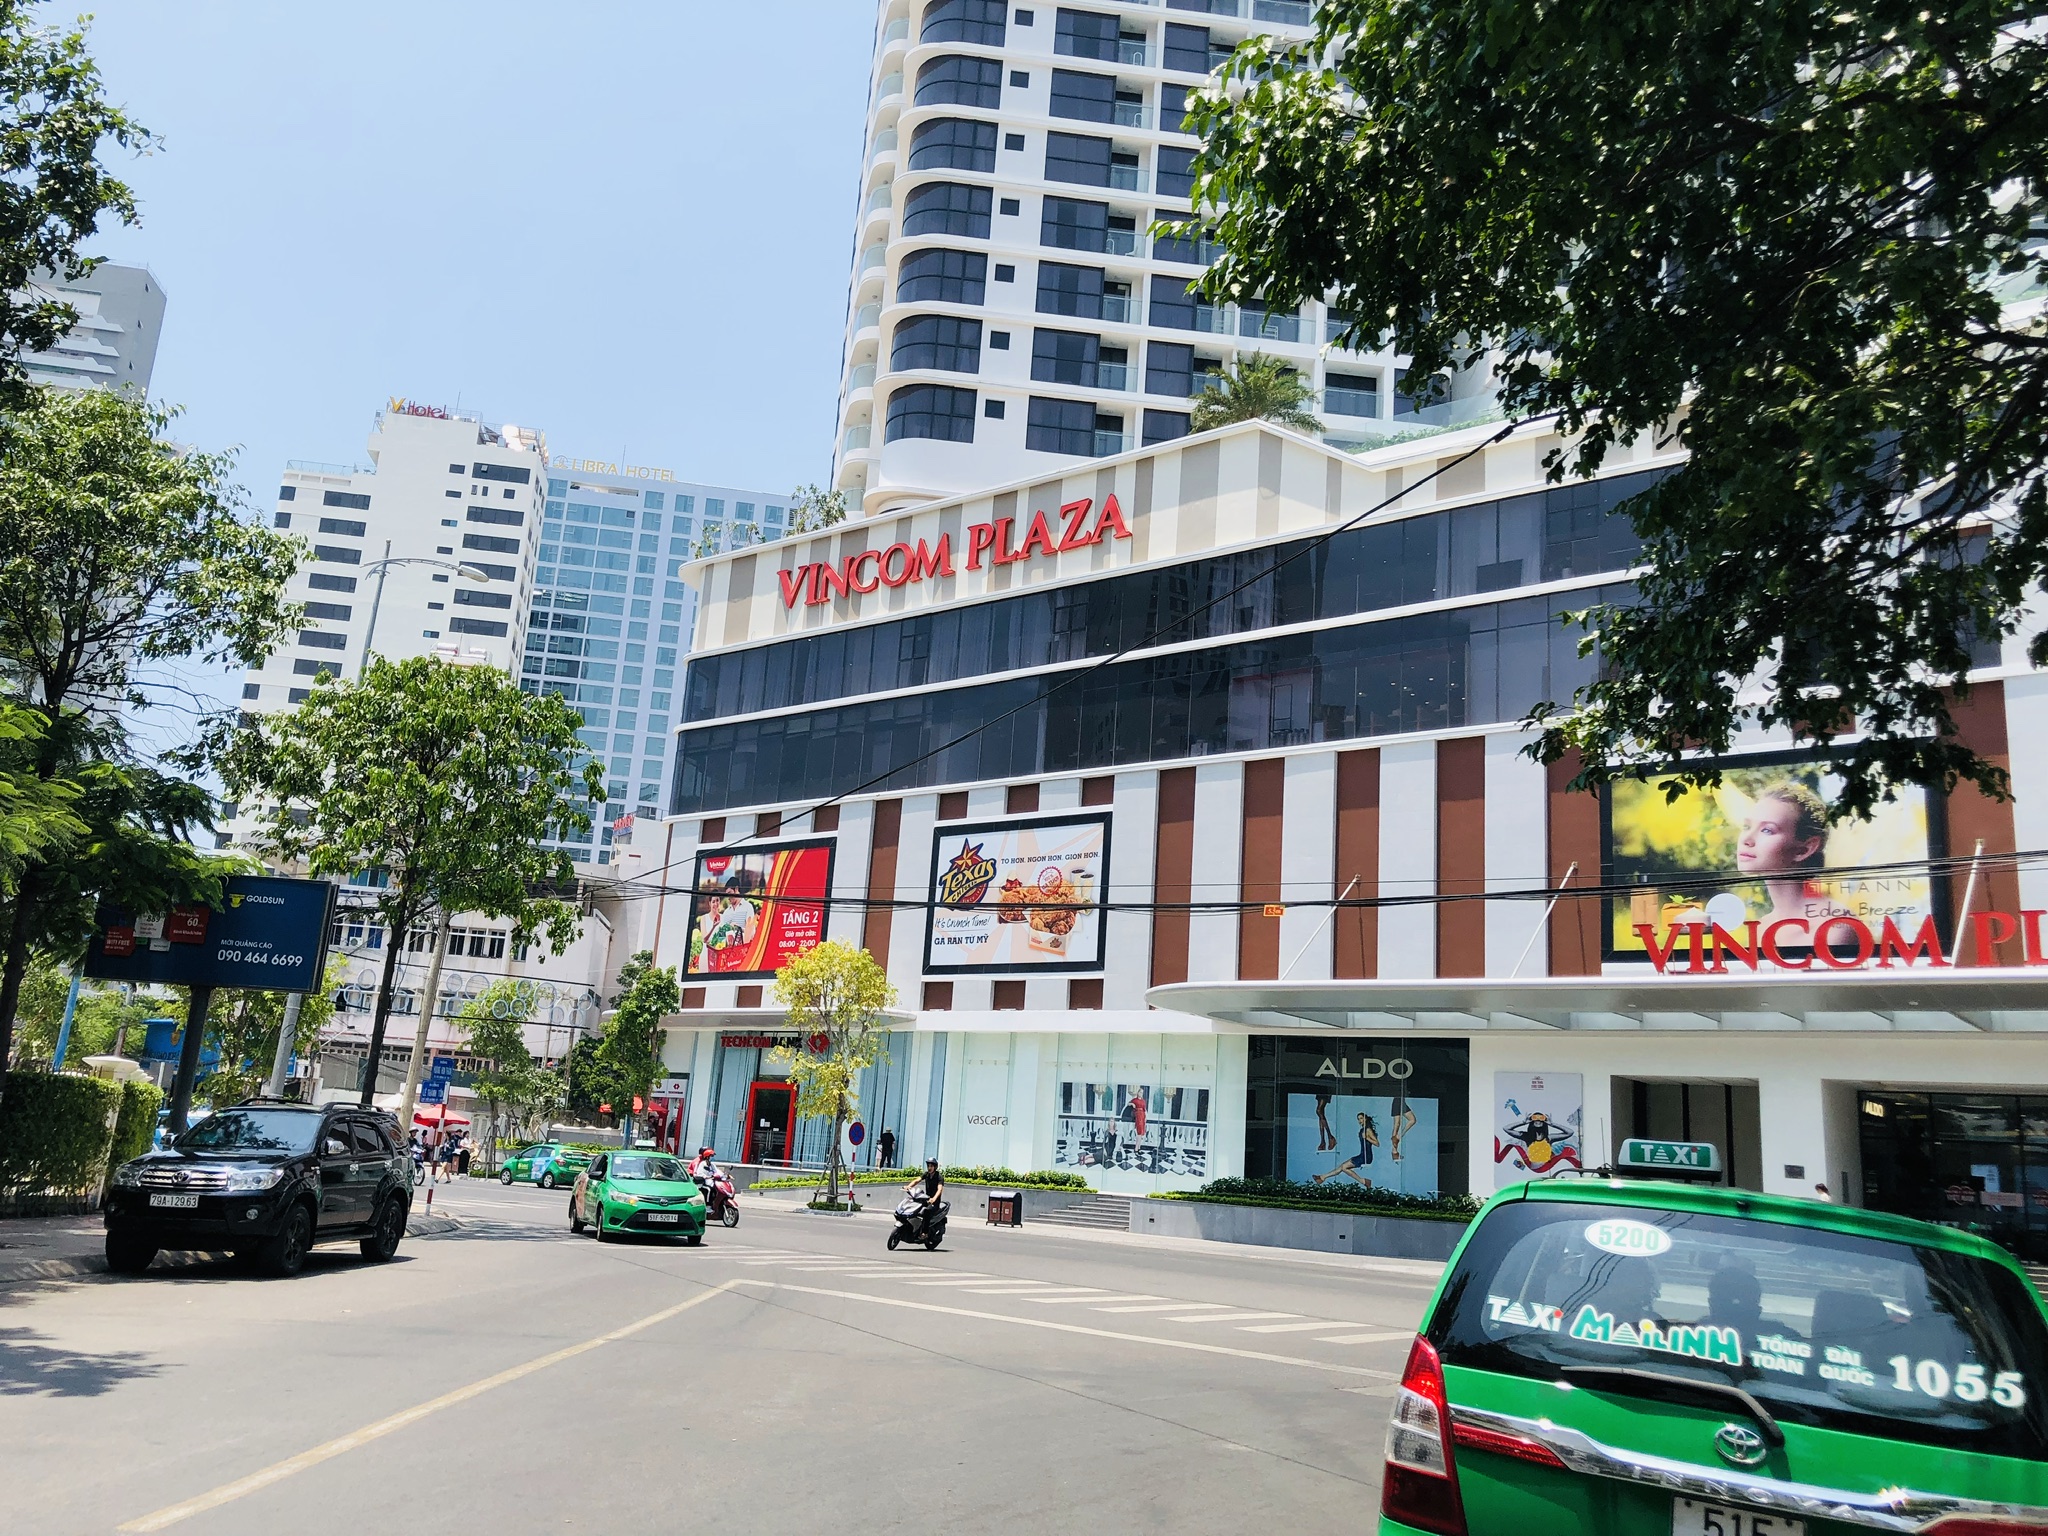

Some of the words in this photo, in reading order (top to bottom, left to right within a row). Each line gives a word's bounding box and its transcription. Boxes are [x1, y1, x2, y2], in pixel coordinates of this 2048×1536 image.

[407, 400, 447, 419] Hotel
[572, 458, 618, 475] LIBRA
[626, 465, 677, 482] HOTEL
[776, 532, 956, 609] VINCOM
[965, 493, 1133, 571] PLAZA
[941, 859, 995, 901] Texas
[1826, 880, 1912, 895] THANN
[246, 895, 285, 905] GOLDSUN
[1805, 901, 1856, 918] Eden
[1858, 902, 1920, 917] Breeze
[187, 917, 199, 928] 60
[782, 908, 811, 925] TẦNG
[812, 911, 819, 923] 2
[935, 917, 946, 928] It's
[946, 916, 971, 928] Crunch
[972, 914, 992, 927] Time!
[258, 941, 273, 949] CÁO
[1633, 914, 1953, 972] VINCOM
[217, 949, 241, 962] 090
[244, 951, 268, 965] 464
[271, 953, 303, 967] 6699
[1315, 1057, 1414, 1080] ALDO
[967, 1115, 1009, 1126] vascara
[1598, 1225, 1660, 1251] 5200
[1756, 1334, 1812, 1359] TỔNG
[1824, 1345, 1862, 1368] ĐÀI
[1750, 1351, 1805, 1376] TOÀN
[1818, 1363, 1875, 1387] QUỐC
[1888, 1354, 2026, 1409] 1055
